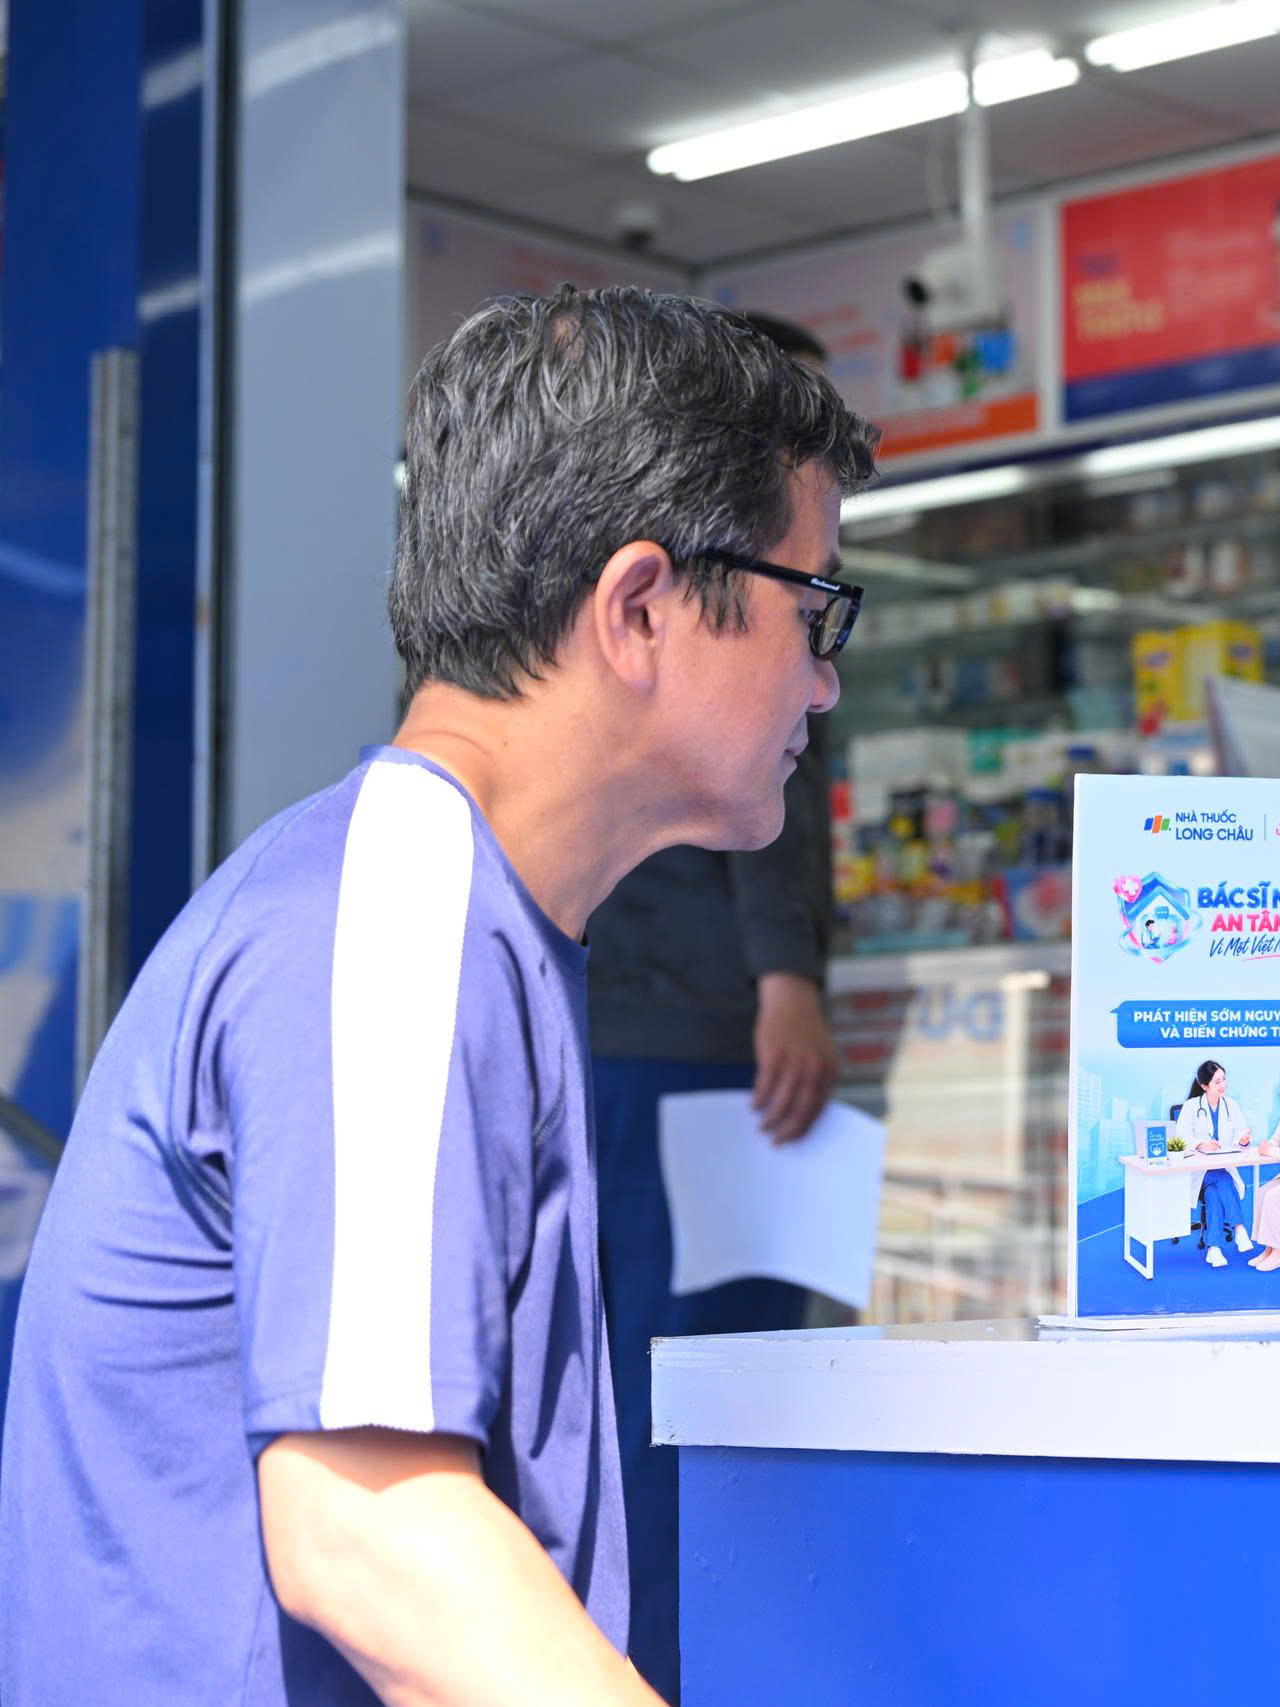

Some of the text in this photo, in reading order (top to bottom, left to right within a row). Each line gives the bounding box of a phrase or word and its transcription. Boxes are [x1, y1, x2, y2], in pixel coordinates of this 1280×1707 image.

[1176, 808, 1237, 823] NHÀ THUỐC
[1175, 824, 1253, 841] LONG CHÂU
[1197, 881, 1245, 909] BÁC
[1246, 881, 1271, 909] SĨ
[1211, 913, 1243, 933] AN
[1223, 936, 1250, 957] Một
[1250, 933, 1277, 955] Việt
[1133, 1008, 1171, 1023] PHÁT
[1174, 1008, 1207, 1025] HIỆN
[1210, 1007, 1241, 1023] SỚM
[1160, 1024, 1181, 1039] VÀ
[1183, 1023, 1216, 1039] BIẾN
[1219, 1024, 1268, 1038] CHỨNG
